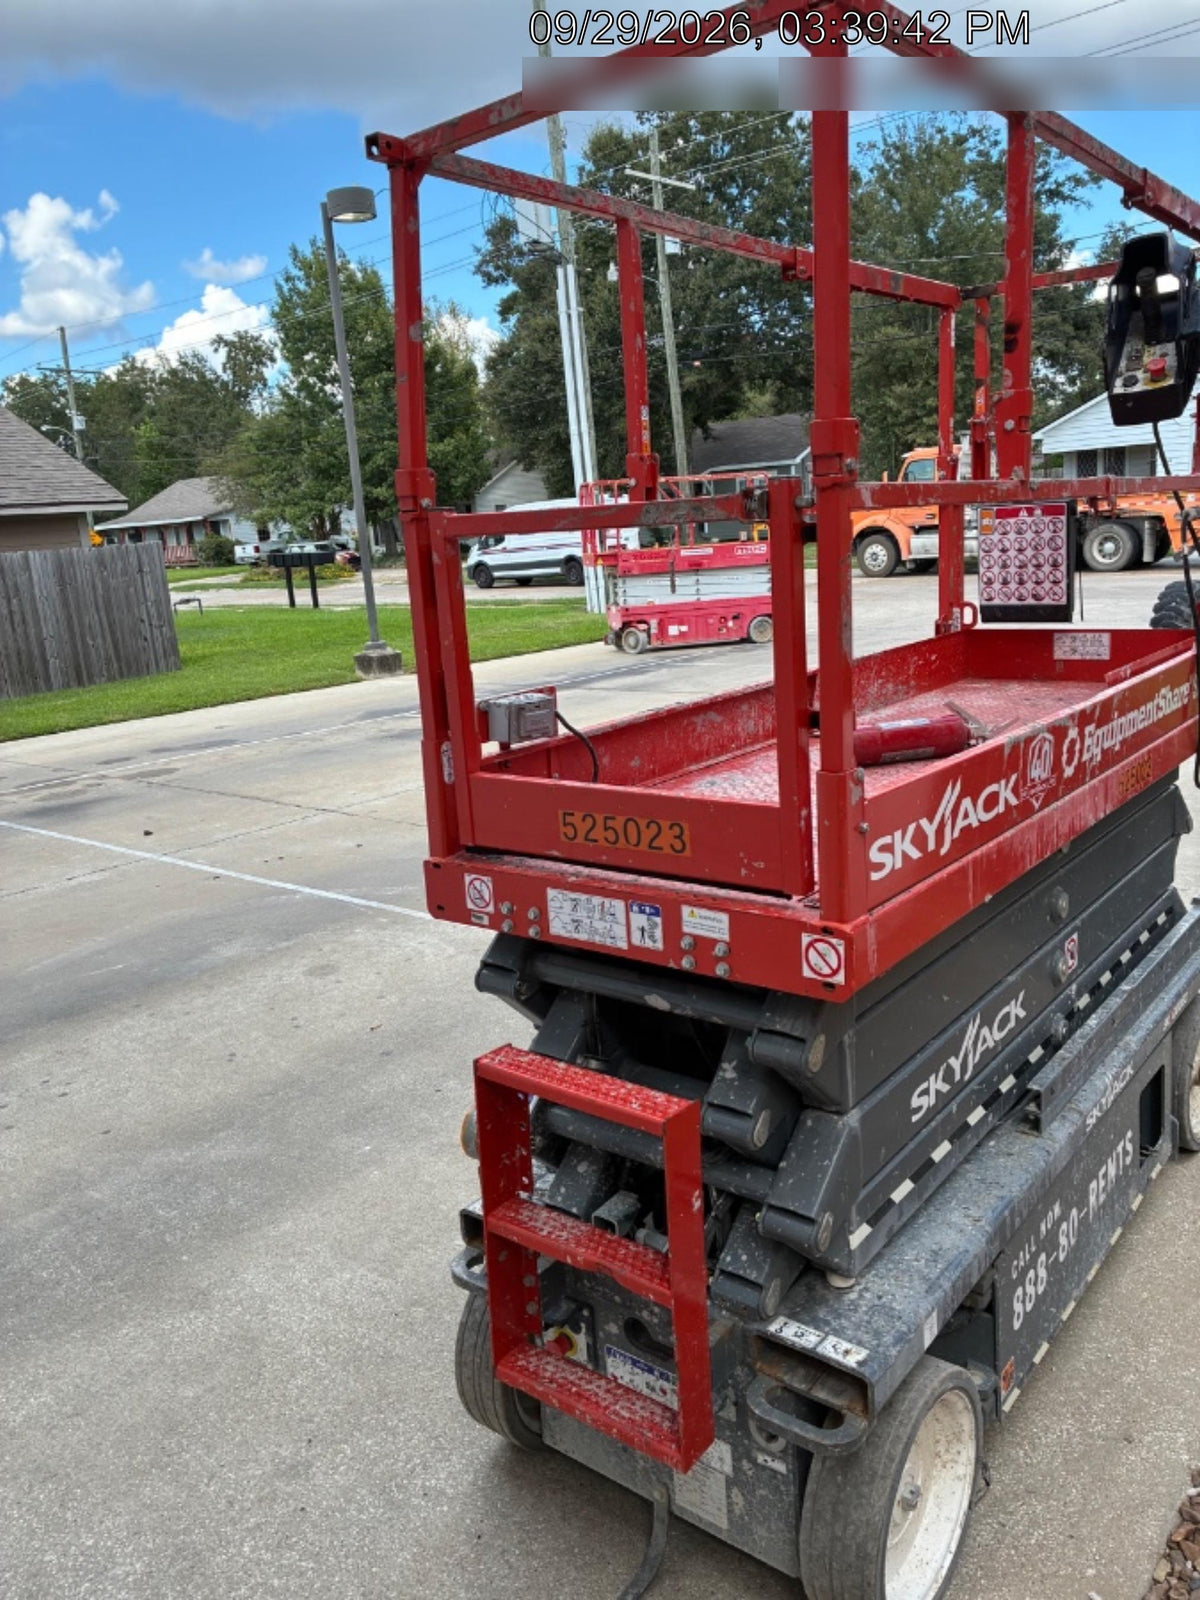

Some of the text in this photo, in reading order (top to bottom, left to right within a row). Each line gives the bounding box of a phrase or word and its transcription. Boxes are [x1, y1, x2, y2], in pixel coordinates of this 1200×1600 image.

[562, 811, 688, 854] 525023
[869, 773, 1019, 881] SKYJACK
[910, 990, 1026, 1122] SKYJACK
[1011, 1198, 1062, 1280] CALL NOW
[1013, 1128, 1134, 1331] 888-80-RENTS
